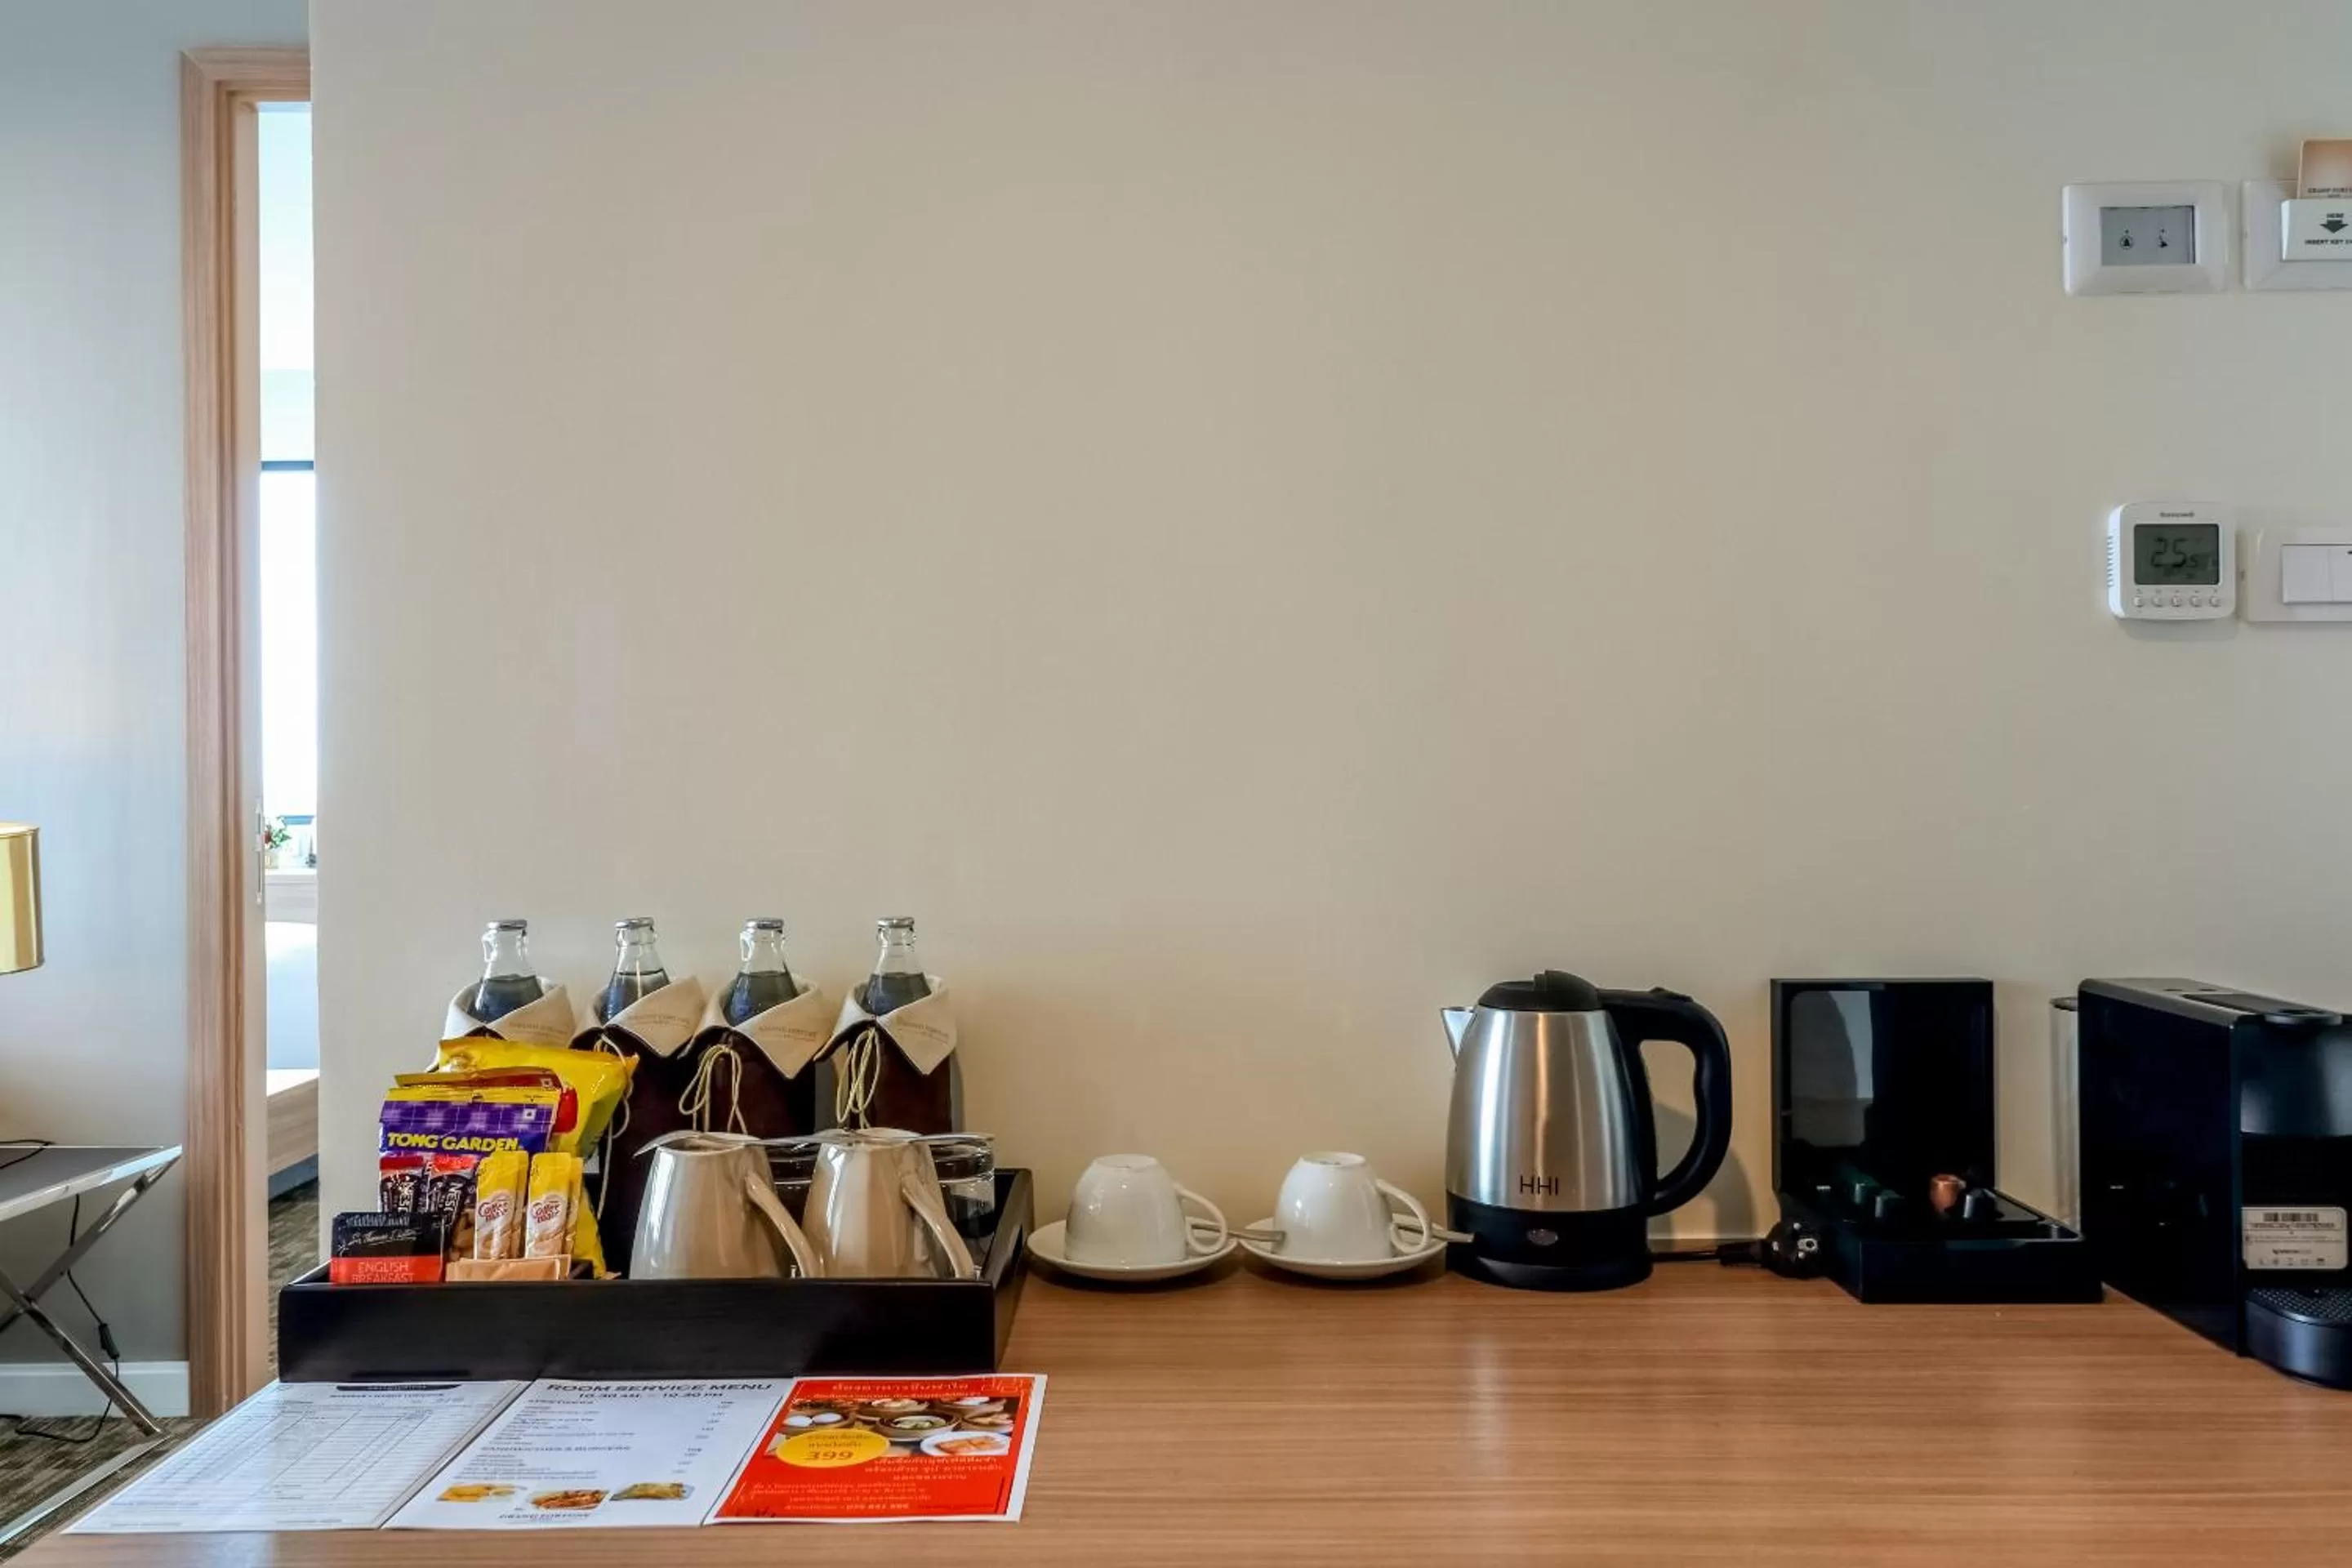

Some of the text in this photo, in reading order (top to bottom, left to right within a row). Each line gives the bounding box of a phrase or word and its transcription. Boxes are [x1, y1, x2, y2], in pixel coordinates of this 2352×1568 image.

[386, 1132, 519, 1152] TONG GARDEN
[1519, 1174, 1560, 1196] HHI
[358, 1260, 409, 1273] ENGLISH
[351, 1272, 415, 1283] BREAKFAST
[546, 1383, 773, 1392] ROOM SERVICE MENU
[804, 1450, 855, 1461] 399
